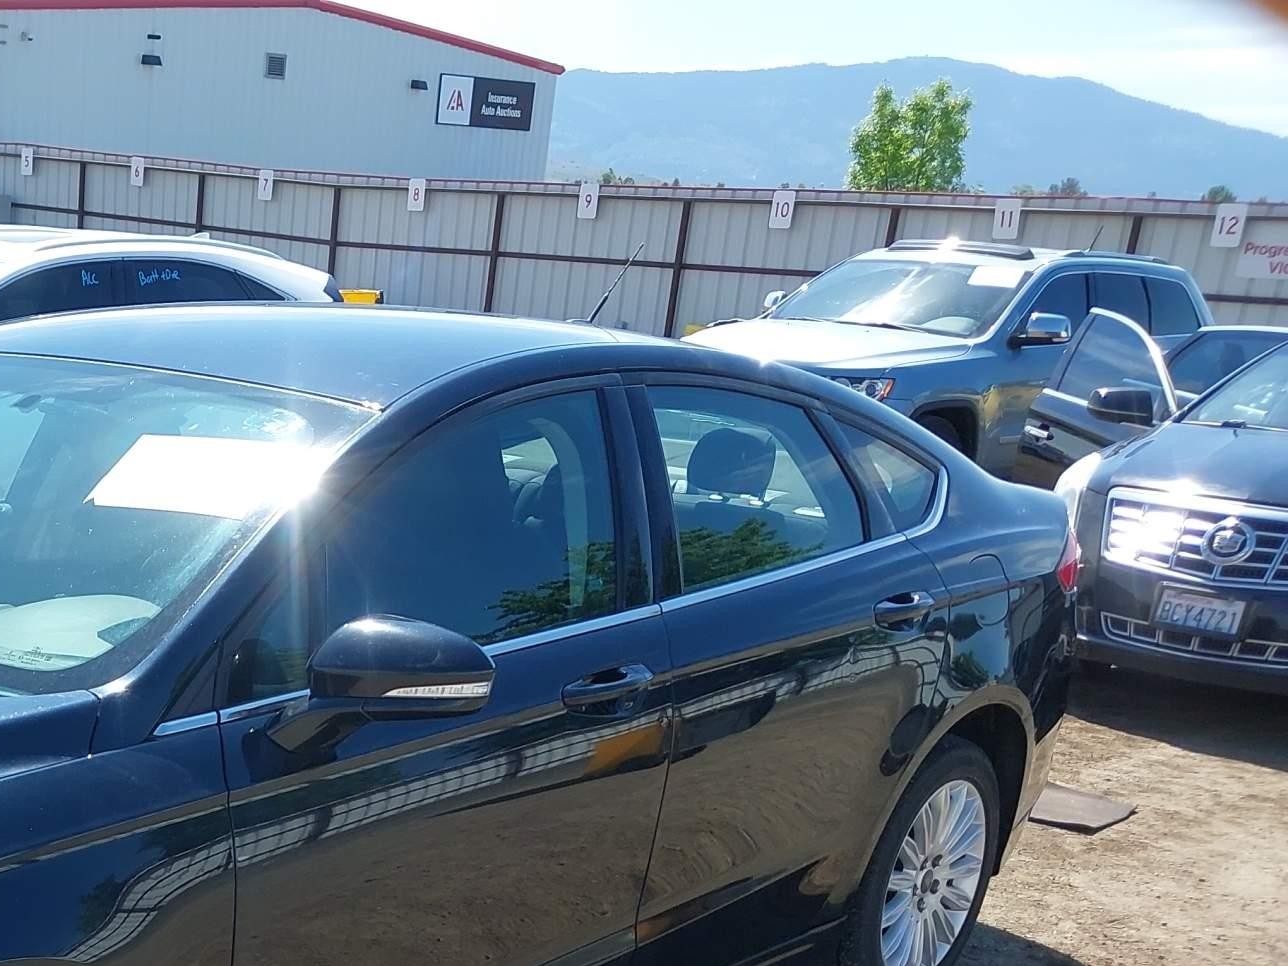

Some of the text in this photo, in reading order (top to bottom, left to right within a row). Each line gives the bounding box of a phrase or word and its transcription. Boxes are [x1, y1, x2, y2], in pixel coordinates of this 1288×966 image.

[487, 91, 518, 105] Insurance
[480, 104, 522, 118] Auto Auctions
[24, 155, 30, 168] 5
[134, 166, 140, 178] 6
[263, 178, 269, 191] 7
[413, 187, 420, 202] 8
[585, 193, 592, 208] 9
[775, 201, 790, 218] 10
[1000, 210, 1014, 228] 11
[1218, 216, 1239, 235] 12
